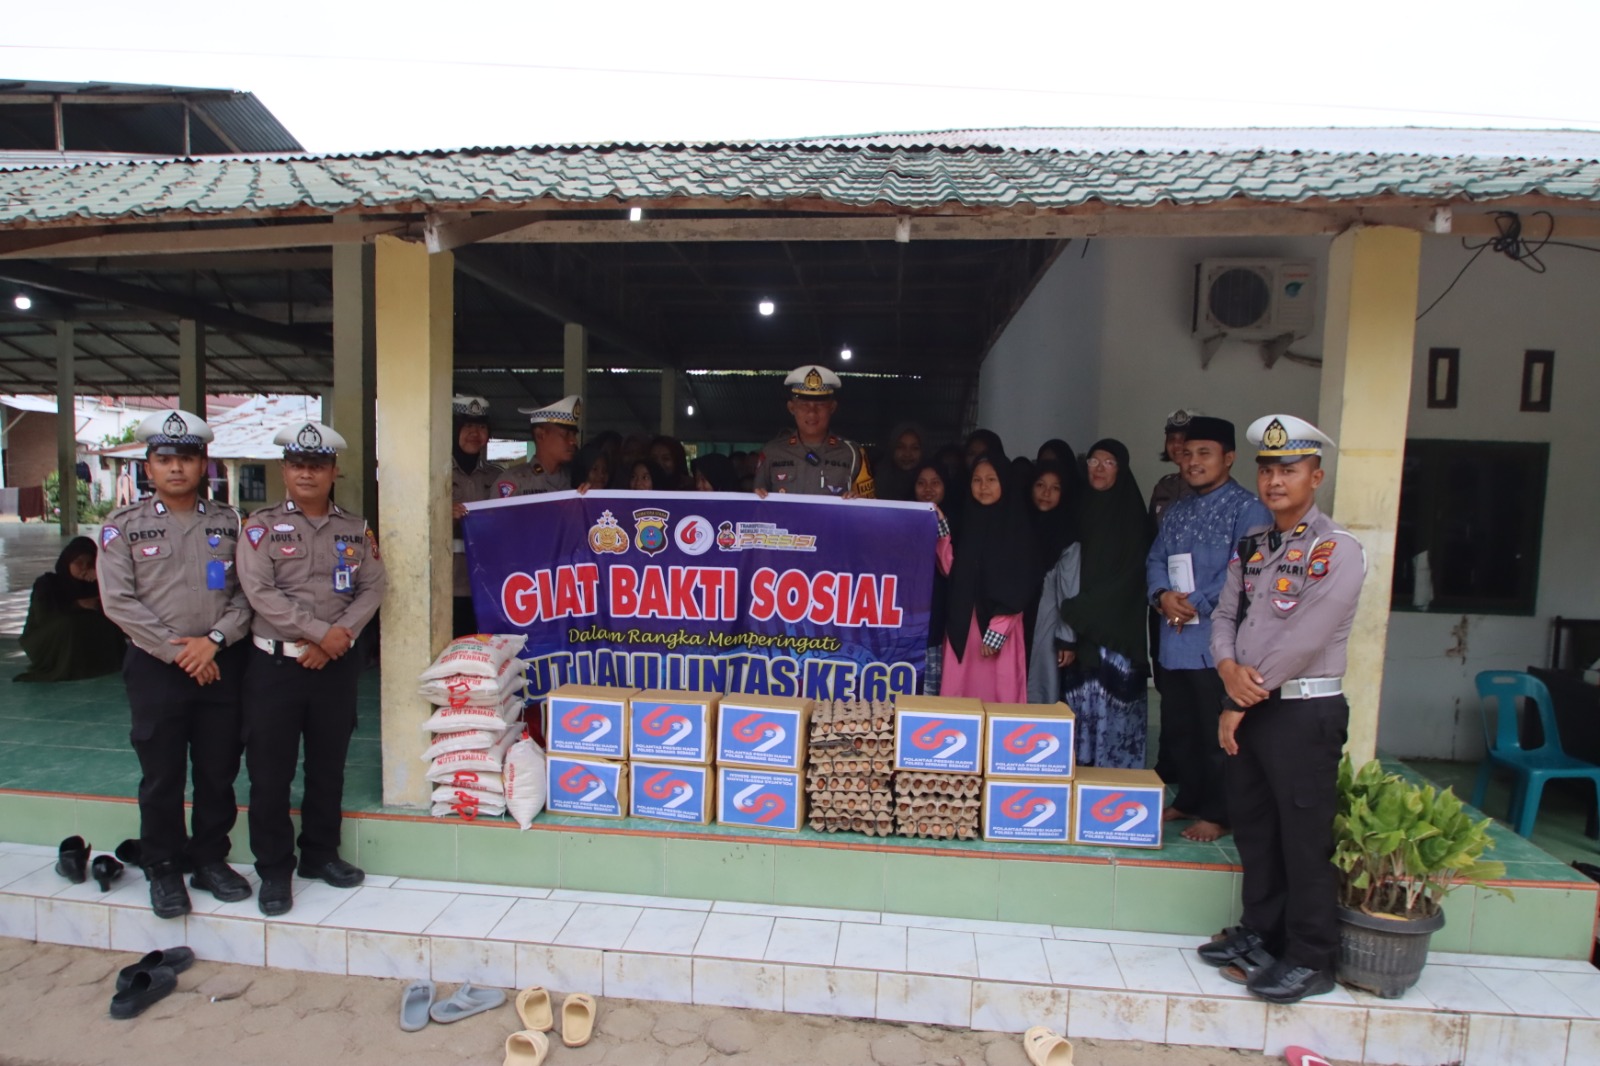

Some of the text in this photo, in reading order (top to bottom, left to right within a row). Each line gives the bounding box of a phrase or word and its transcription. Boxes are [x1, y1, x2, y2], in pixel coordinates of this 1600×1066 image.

[129, 529, 166, 541] DEDY
[334, 534, 363, 544] POLRI
[741, 534, 815, 547] PRESISI
[502, 563, 903, 627] GIAT BAKTI SOSIAL
[568, 625, 841, 652] Dalam Rangka Memperingati
[516, 651, 573, 699] UT
[666, 653, 799, 698] LINTAS
[803, 658, 857, 703] KE
[860, 662, 916, 703] 69
